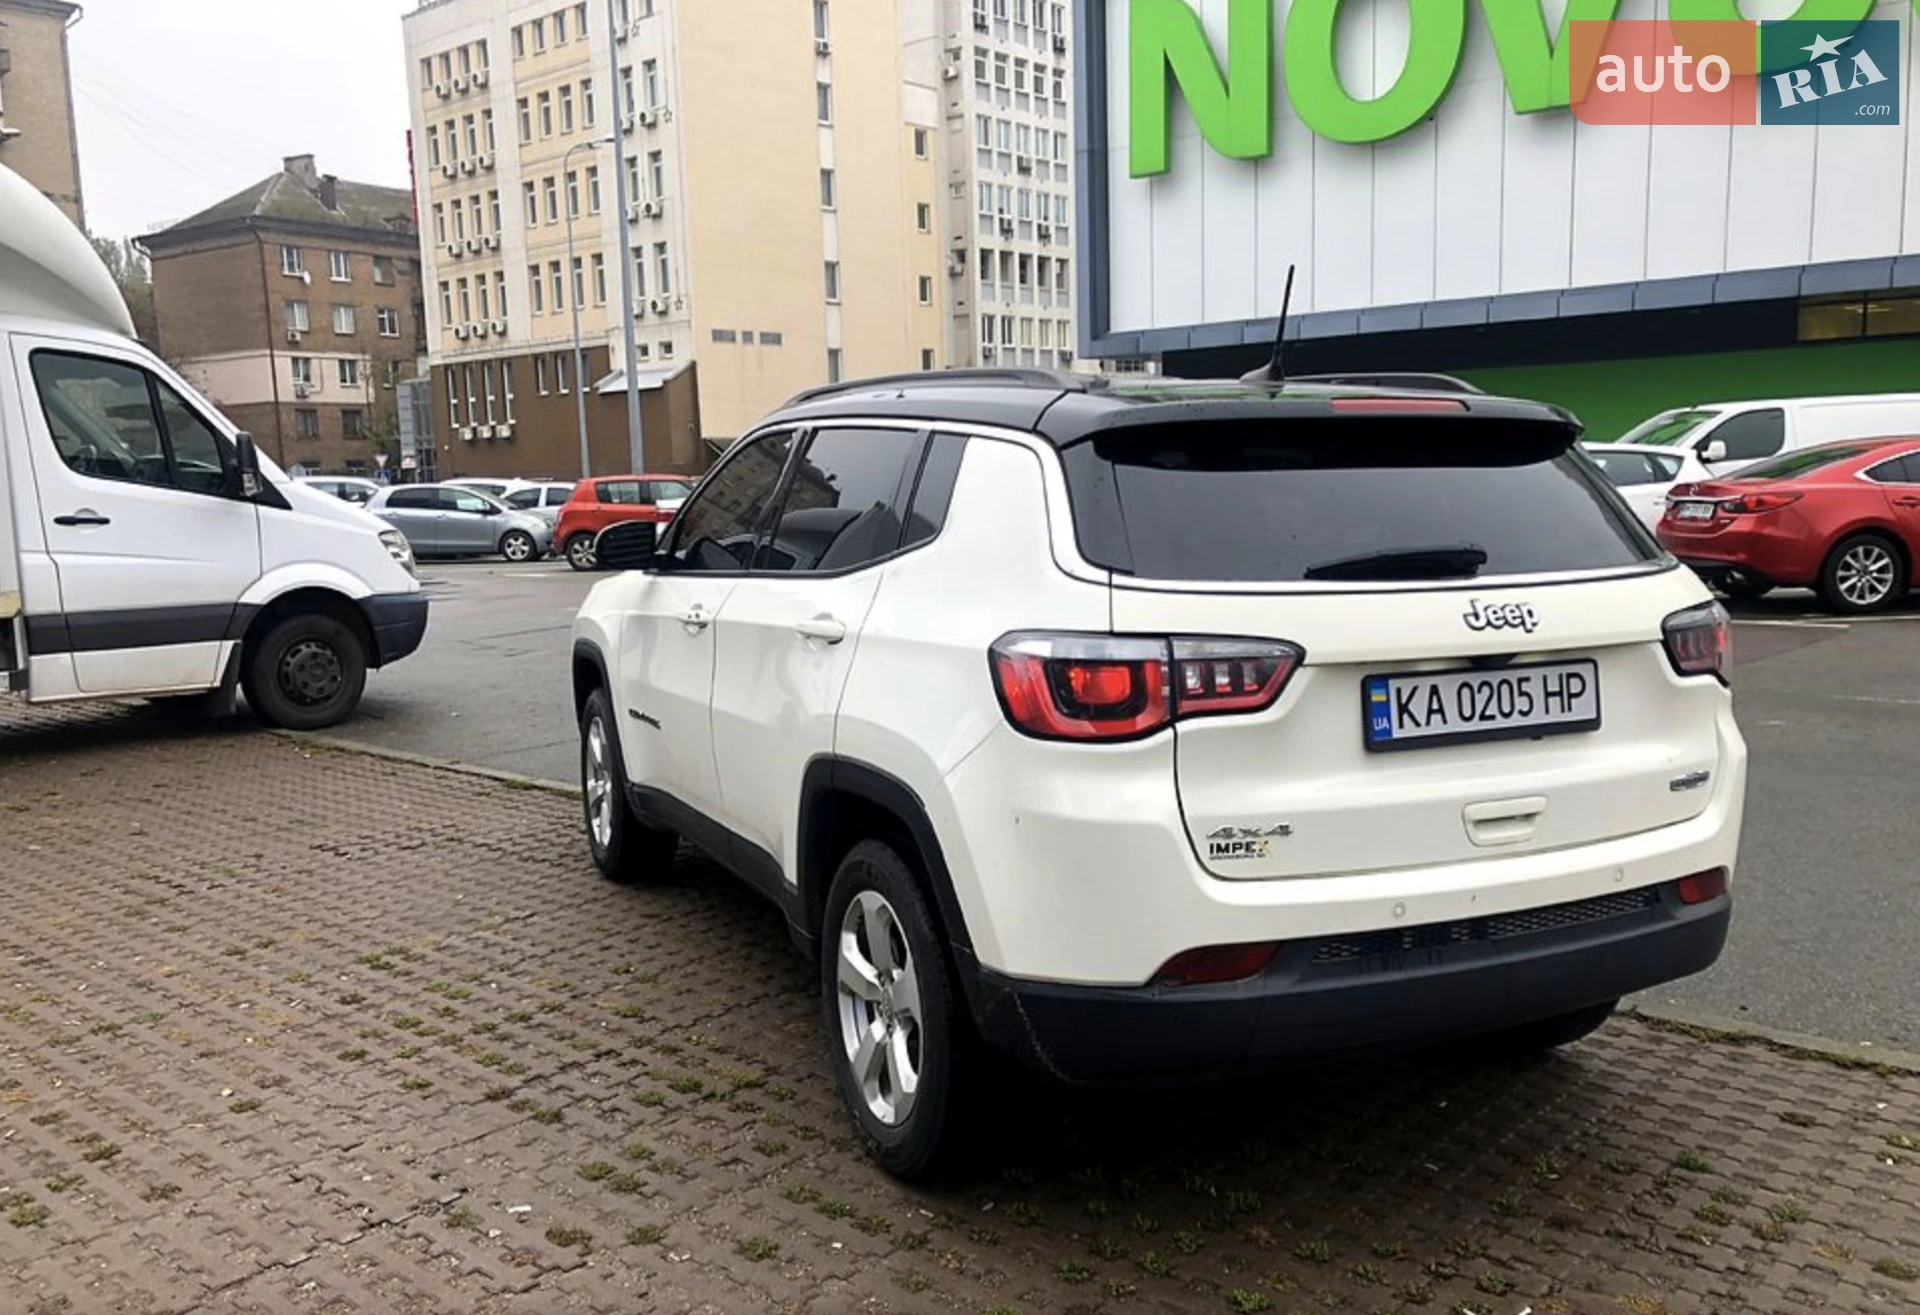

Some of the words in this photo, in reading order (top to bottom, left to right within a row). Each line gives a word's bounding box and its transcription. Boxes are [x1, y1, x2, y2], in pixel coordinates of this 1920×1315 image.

[1463, 599, 1539, 633] Jeep
[1373, 716, 1389, 731] UA
[1395, 683, 1448, 730] KA
[1456, 675, 1535, 723] 0205
[1542, 671, 1587, 715] HP
